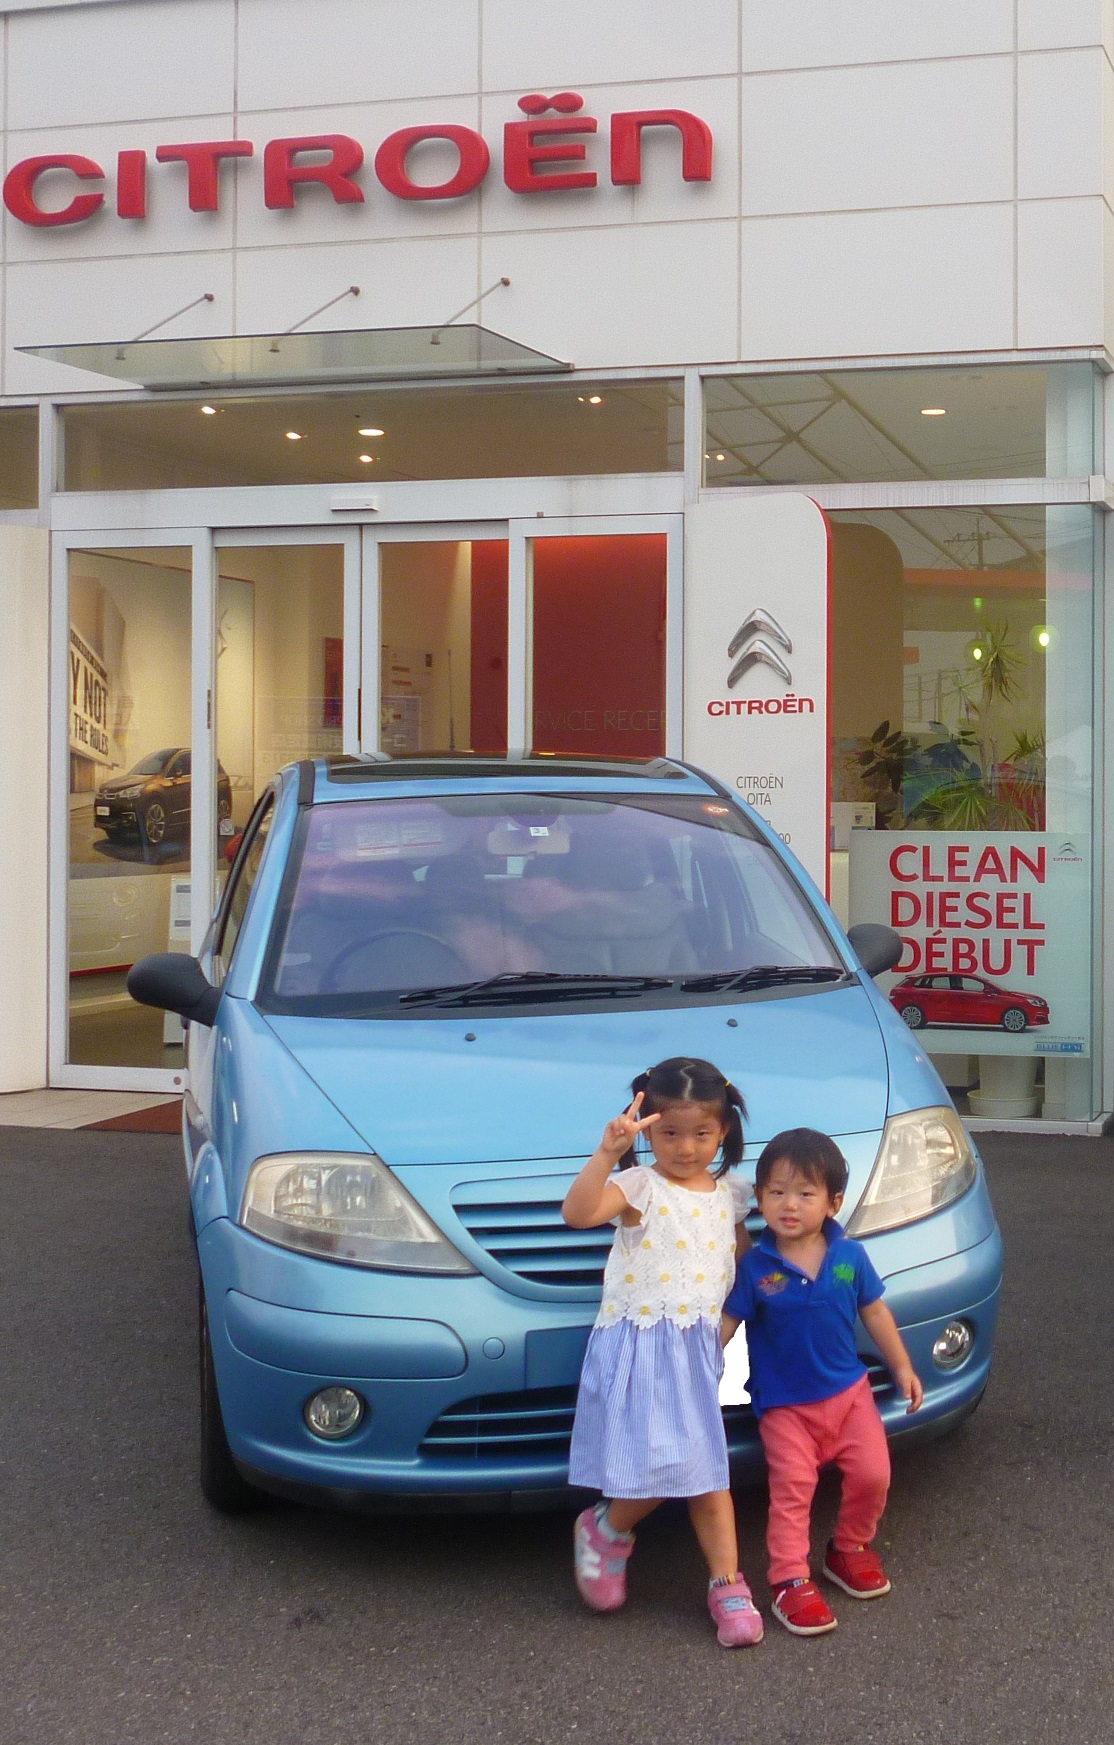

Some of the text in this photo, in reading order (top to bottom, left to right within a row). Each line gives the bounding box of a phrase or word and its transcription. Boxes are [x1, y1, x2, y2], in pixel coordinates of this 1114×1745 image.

[74, 713, 88, 745] THE
[736, 774, 784, 789] CITROËN
[746, 793, 772, 806] OITA
[889, 844, 1046, 883] CLEAN
[890, 890, 1046, 930] DIESEL
[890, 929, 1046, 976] DÉBUT
